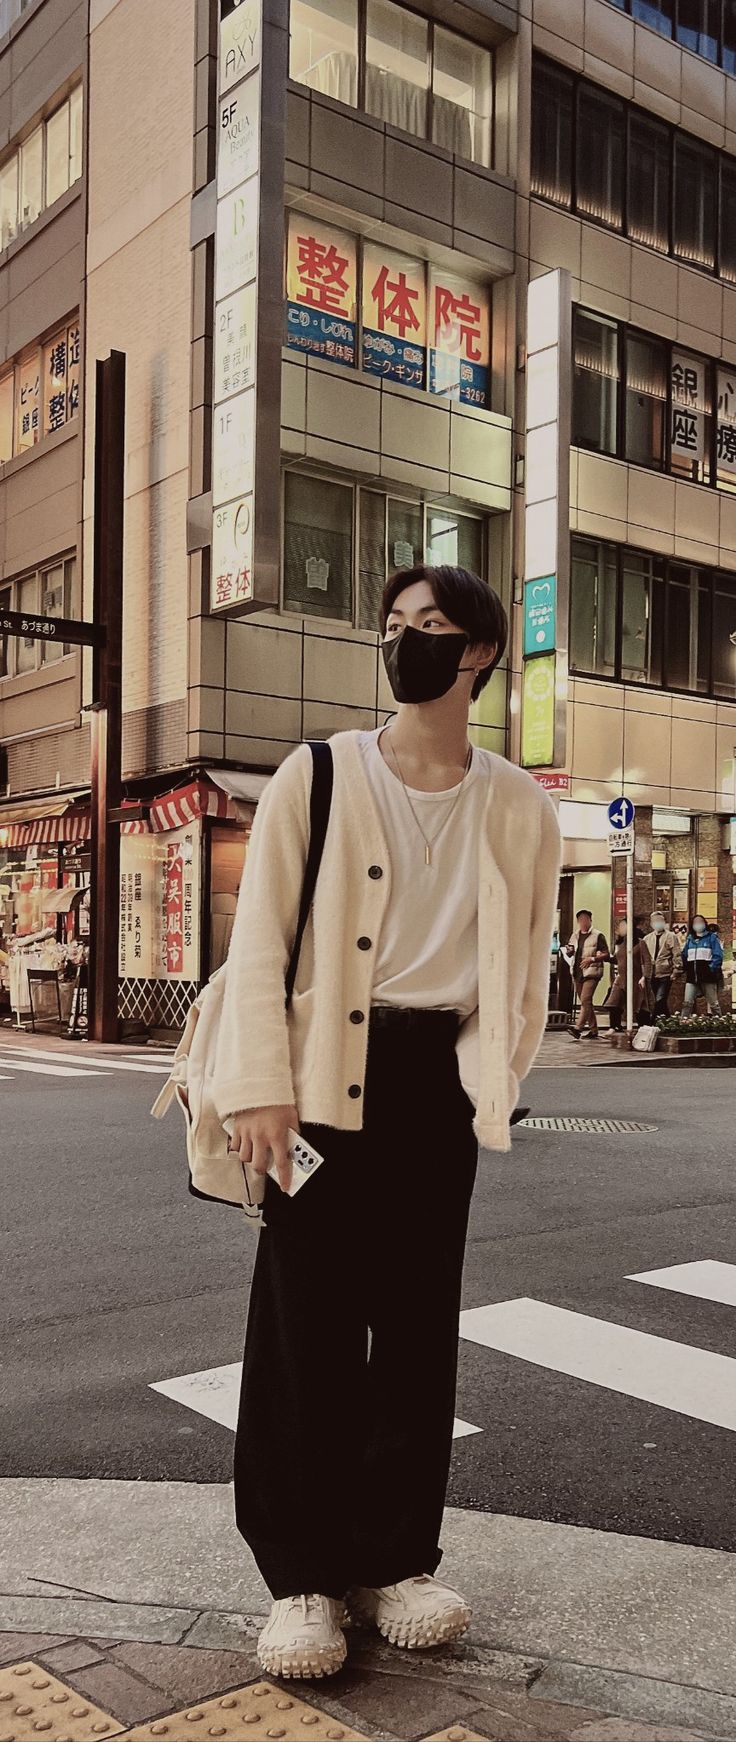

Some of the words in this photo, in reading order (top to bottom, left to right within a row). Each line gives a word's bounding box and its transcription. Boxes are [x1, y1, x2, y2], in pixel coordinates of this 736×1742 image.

[226, 29, 256, 78] AXY
[221, 100, 238, 129] 5F
[225, 116, 250, 144] AQUA
[296, 236, 482, 362] 整体院
[220, 309, 233, 332] 2F
[671, 363, 698, 451] 銀座
[219, 413, 233, 434] 1F
[216, 512, 228, 528] 3F
[216, 566, 250, 604] 整体
[21, 620, 56, 635] あづま通り
